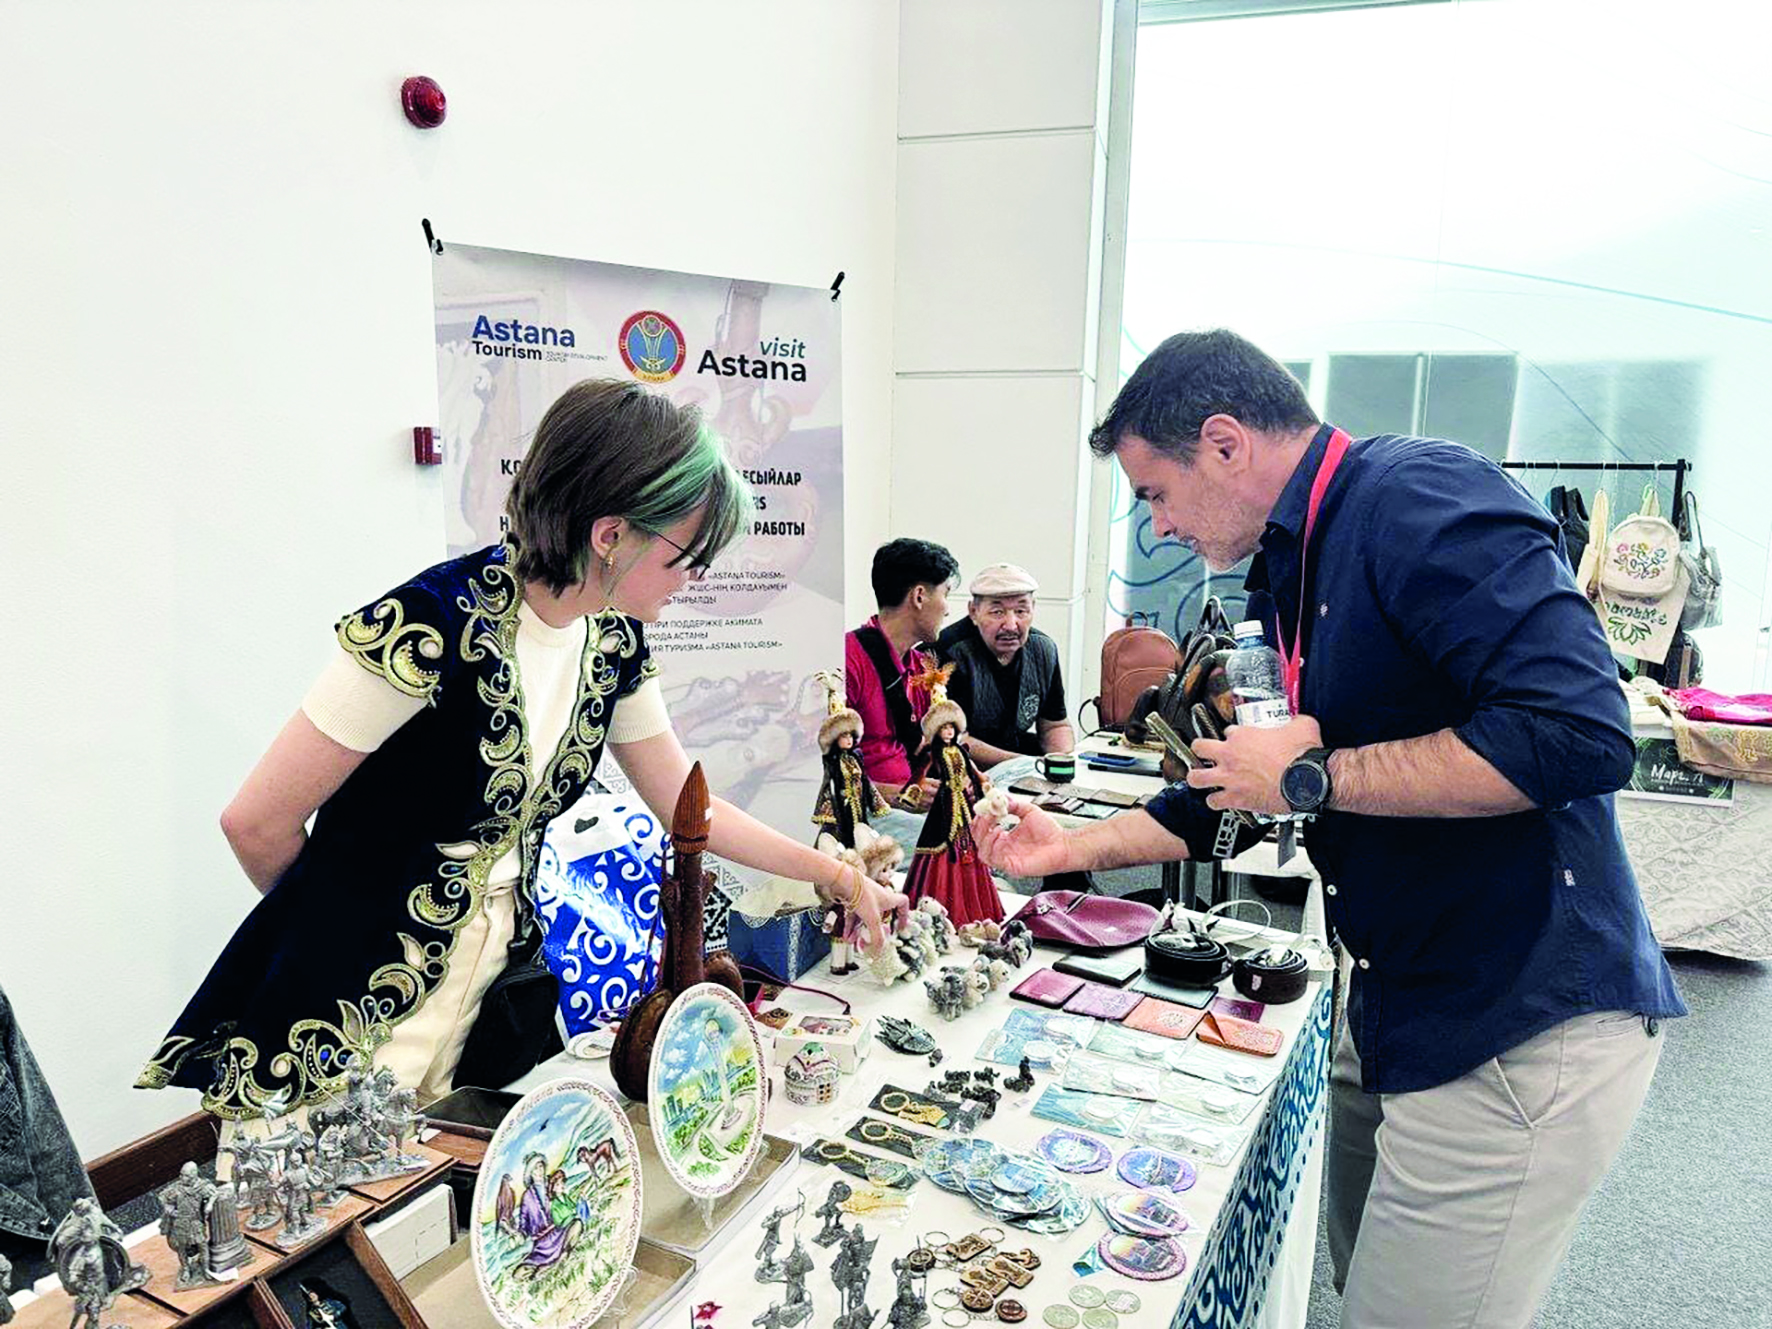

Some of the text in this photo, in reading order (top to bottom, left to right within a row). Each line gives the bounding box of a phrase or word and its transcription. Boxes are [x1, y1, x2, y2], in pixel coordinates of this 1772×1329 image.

[472, 315, 575, 348] Astana
[472, 340, 542, 361] Tourism
[760, 337, 806, 359] visit
[697, 349, 806, 382] Astana
[754, 521, 805, 536] РАБОТЫ
[670, 619, 723, 629] ПОДДЕРЖКЕ
